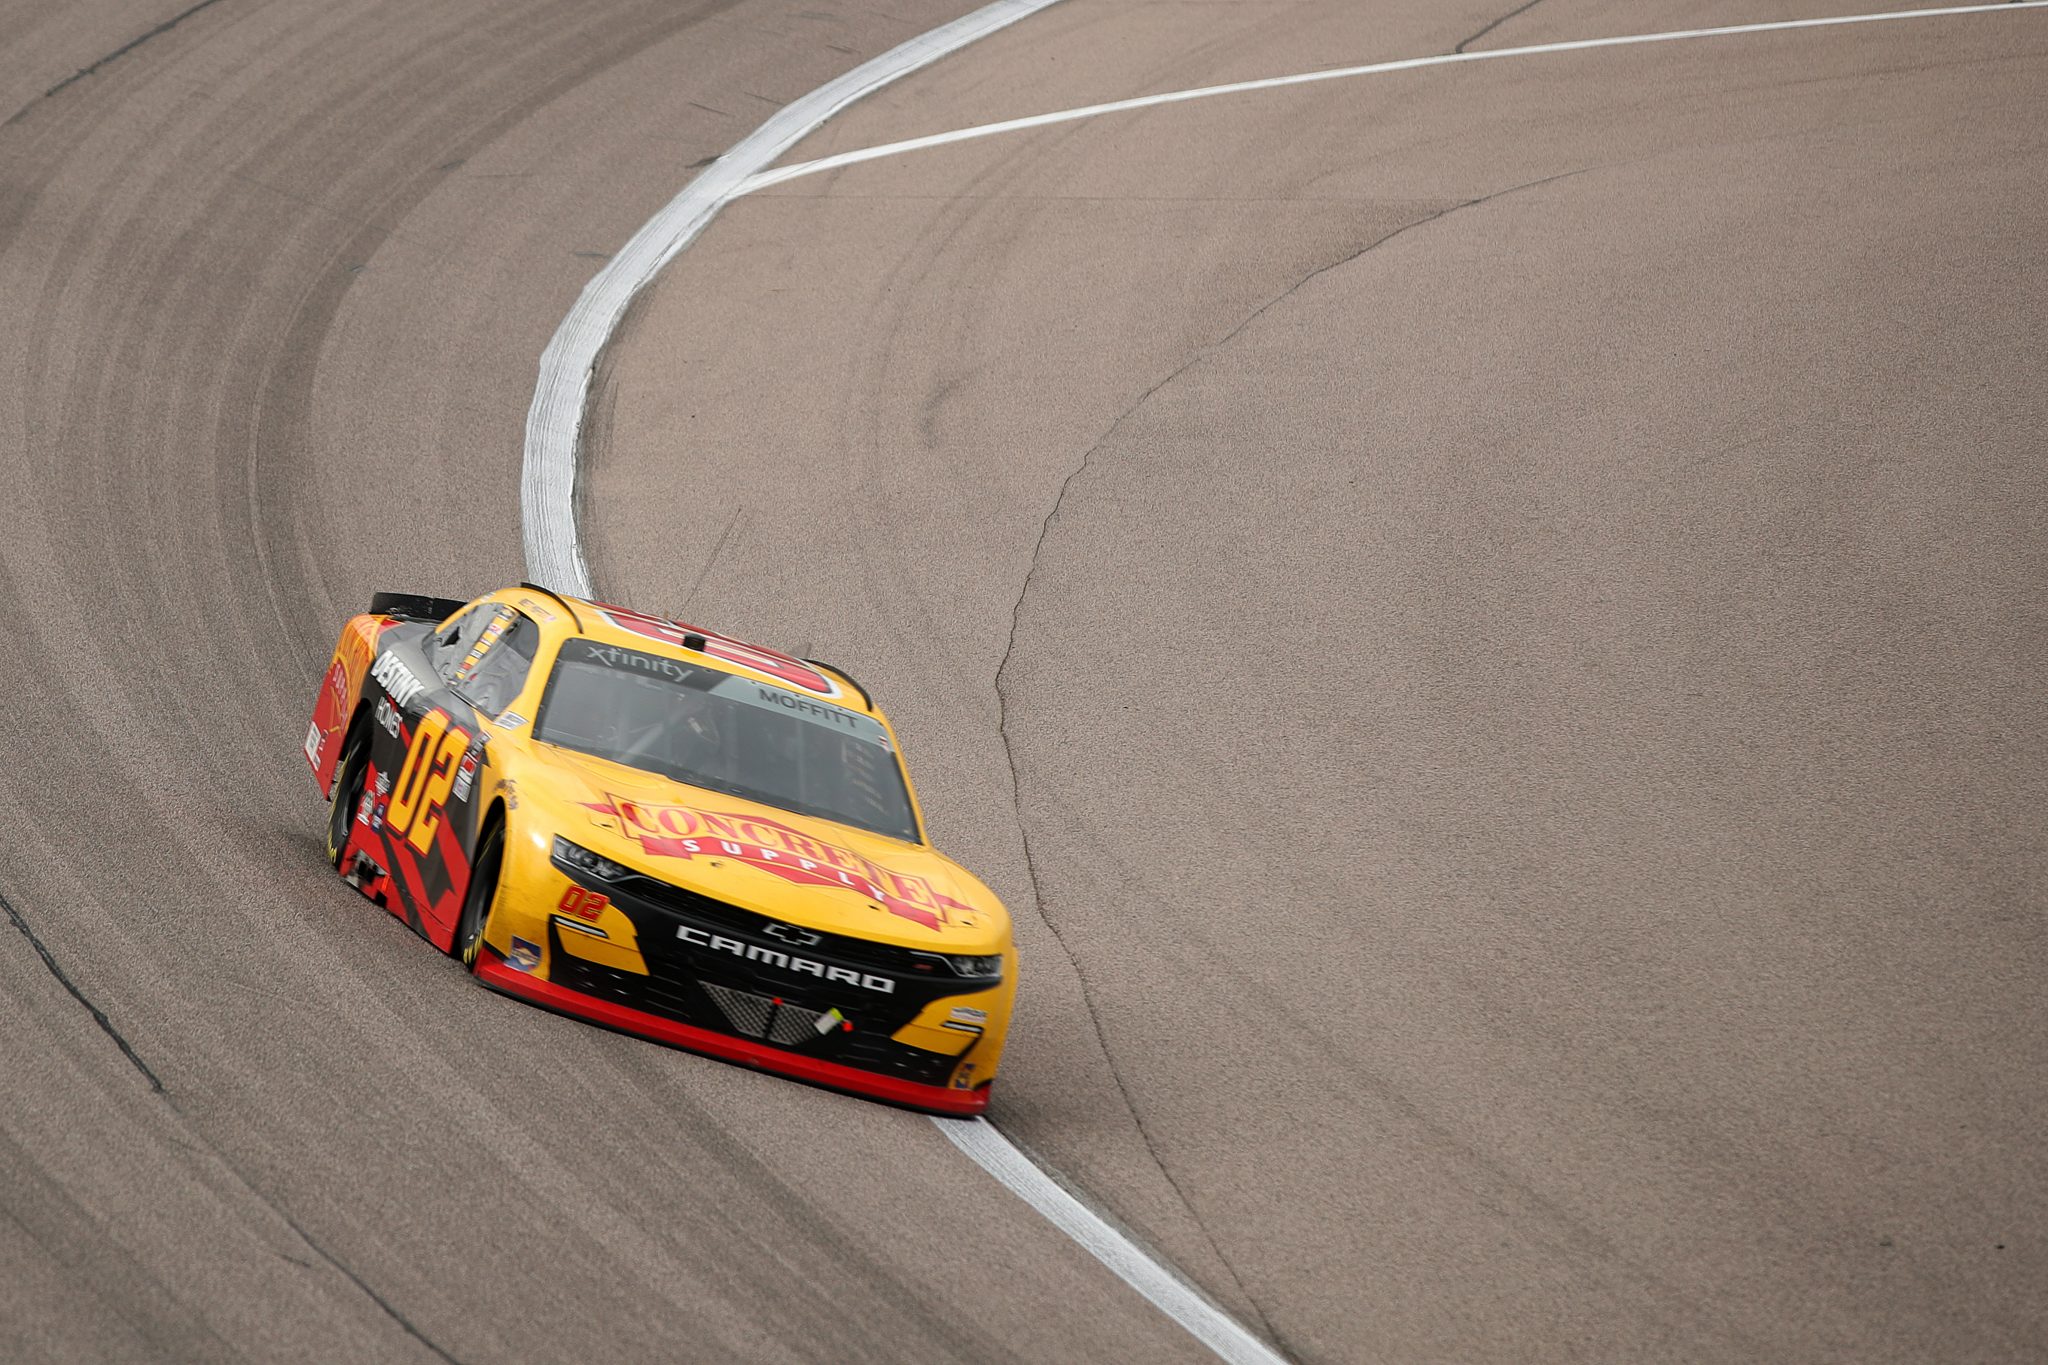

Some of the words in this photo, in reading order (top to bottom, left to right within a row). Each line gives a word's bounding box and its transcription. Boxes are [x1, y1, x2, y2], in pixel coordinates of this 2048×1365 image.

[371, 650, 424, 708] DESTINY
[587, 646, 692, 682] xfinity
[375, 696, 403, 739] HOMES
[759, 688, 858, 728] MOFFITT
[387, 708, 471, 856] 02
[620, 802, 938, 908] CONCRETE
[682, 839, 885, 901] SUPPLY
[558, 885, 609, 922] 02
[676, 925, 896, 994] CAMARO
